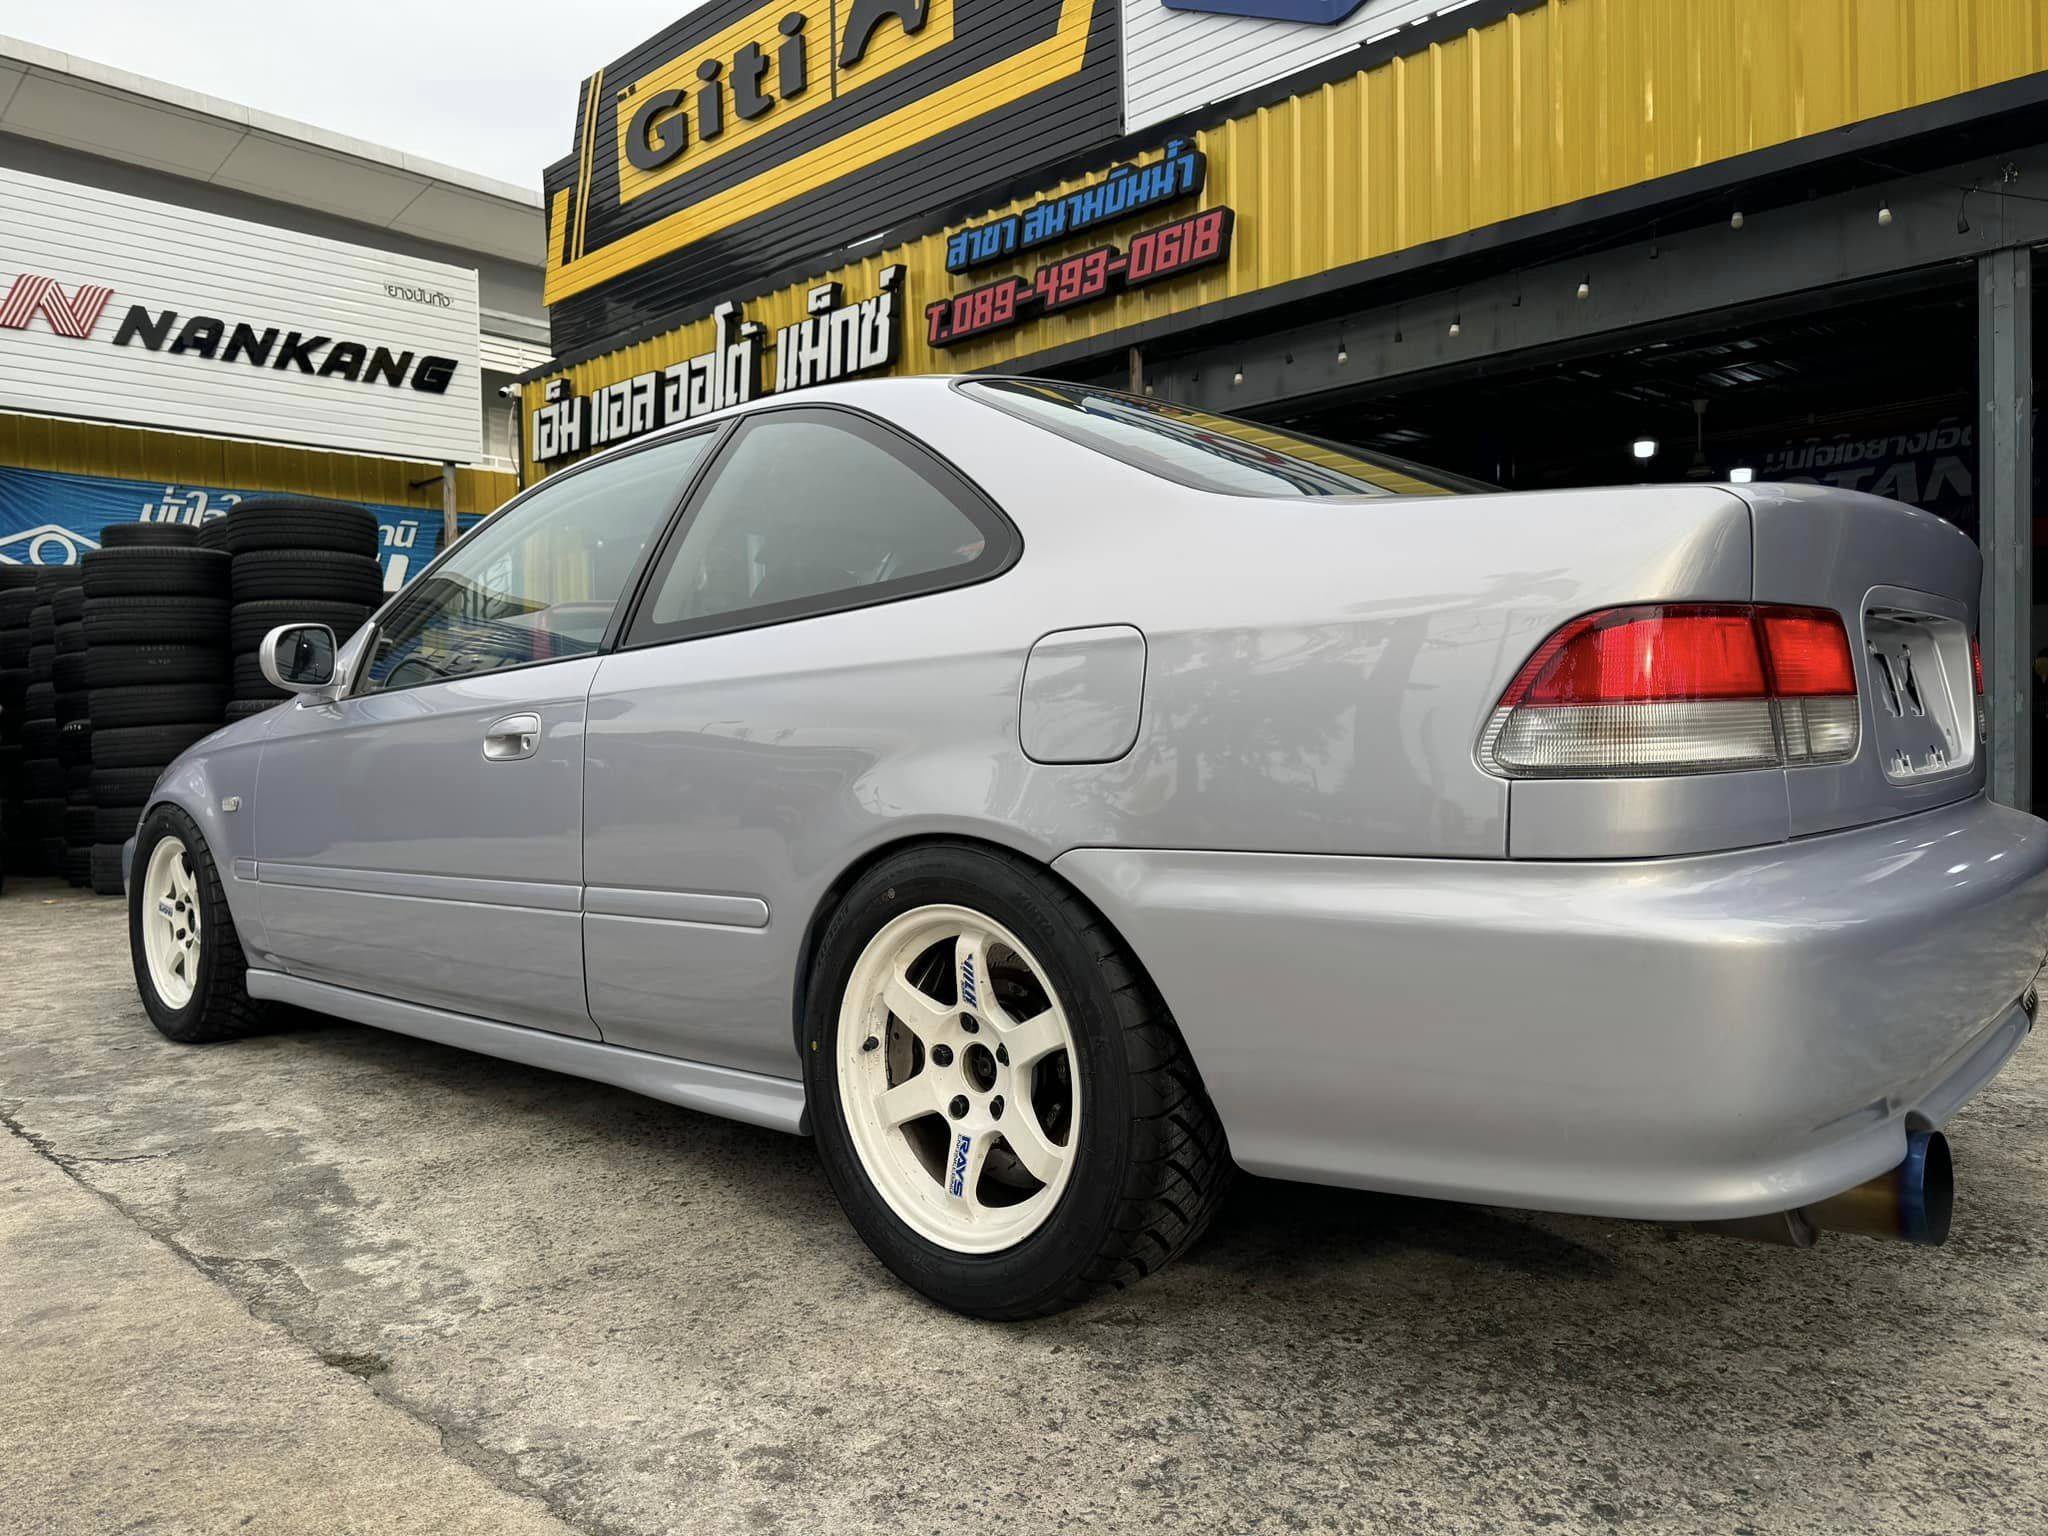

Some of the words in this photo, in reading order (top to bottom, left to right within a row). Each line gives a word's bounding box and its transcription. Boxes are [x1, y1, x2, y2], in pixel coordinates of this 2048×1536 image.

[625, 12, 807, 172] Giti
[947, 217, 1017, 268] สาขา
[1023, 140, 1196, 245] สนามบินน้ำ
[926, 210, 1223, 343] T.089-493-0618
[112, 304, 459, 394] NANKANG
[532, 380, 582, 463] เอ็ม
[590, 371, 657, 446] แอล
[664, 301, 761, 426] ออโต้
[775, 265, 899, 392] แม็กซ์
[953, 1135, 971, 1197] RAYS
